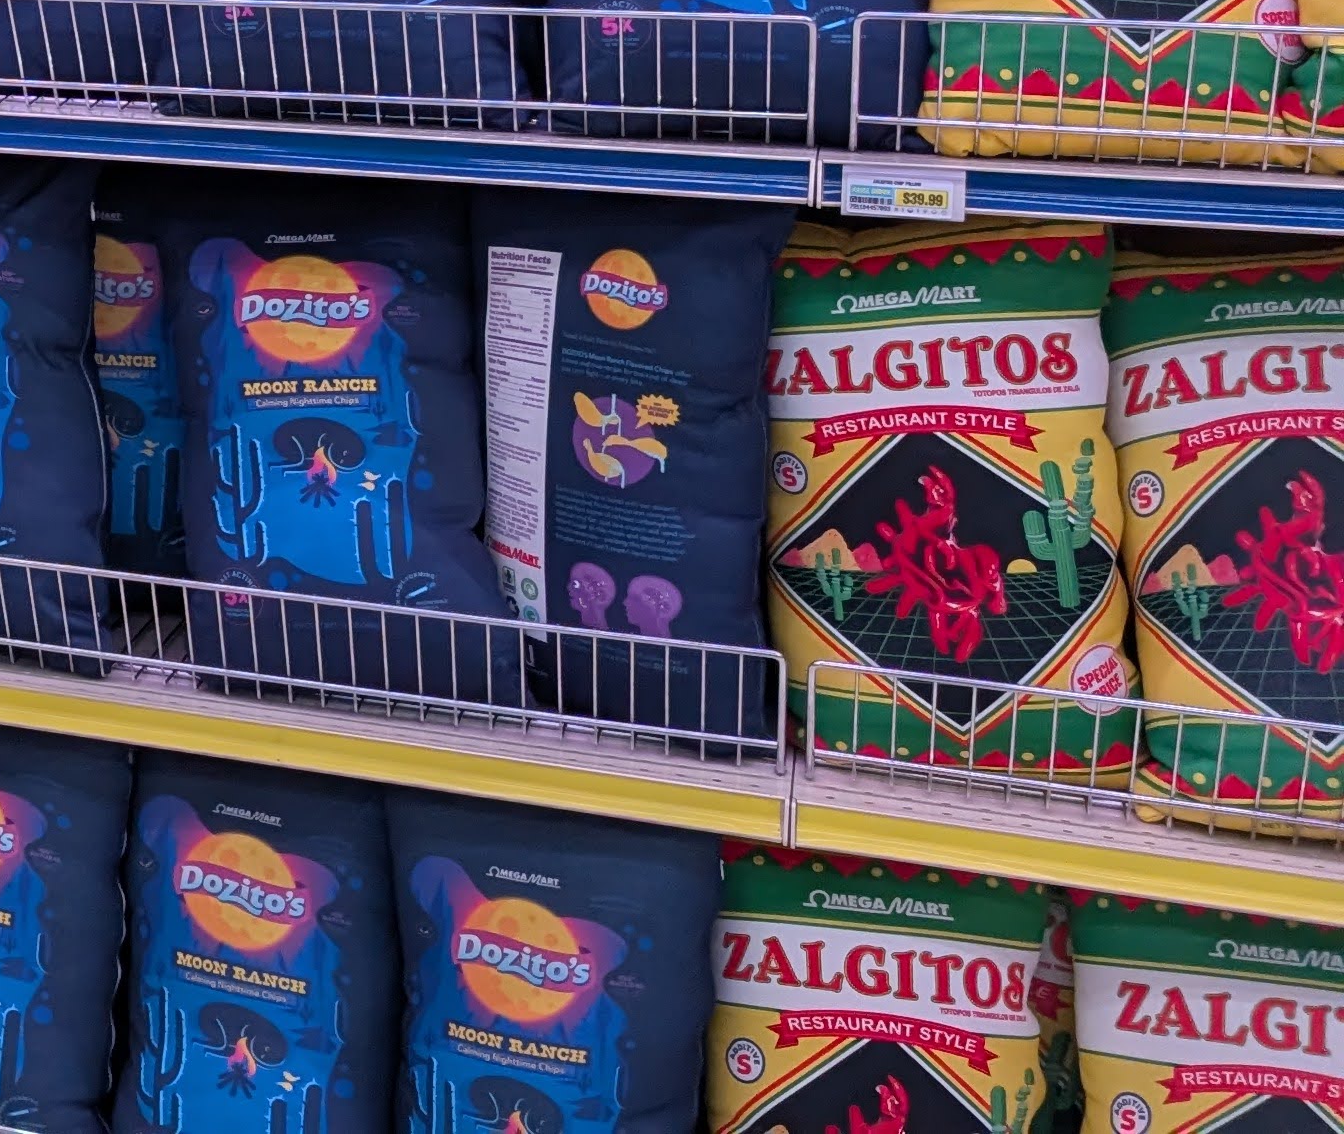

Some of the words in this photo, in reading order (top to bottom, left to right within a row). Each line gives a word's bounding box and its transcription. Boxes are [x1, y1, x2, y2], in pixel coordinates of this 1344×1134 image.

[903, 193, 943, 206] $39.99
[491, 251, 525, 262] Nutrition
[527, 254, 551, 264] Facts
[584, 275, 664, 306] Dozito's
[911, 286, 980, 305] MART
[241, 293, 370, 324] Dozito's
[243, 380, 296, 394] MOON
[304, 378, 376, 393] RANCH
[821, 413, 948, 438] RESTAURANT
[954, 413, 1017, 431] STYLE
[1186, 416, 1326, 448] RESTAURANT
[180, 866, 306, 918] Dozito's
[886, 895, 954, 921] MART
[458, 934, 591, 986] Dozito's
[722, 932, 1027, 1010] ZALGITOS
[448, 1022, 505, 1048] MOON
[511, 1034, 588, 1063] RANCH
[787, 1015, 915, 1040] RESTAURANT
[918, 1025, 978, 1053] STYLE
[736, 1053, 752, 1074] S
